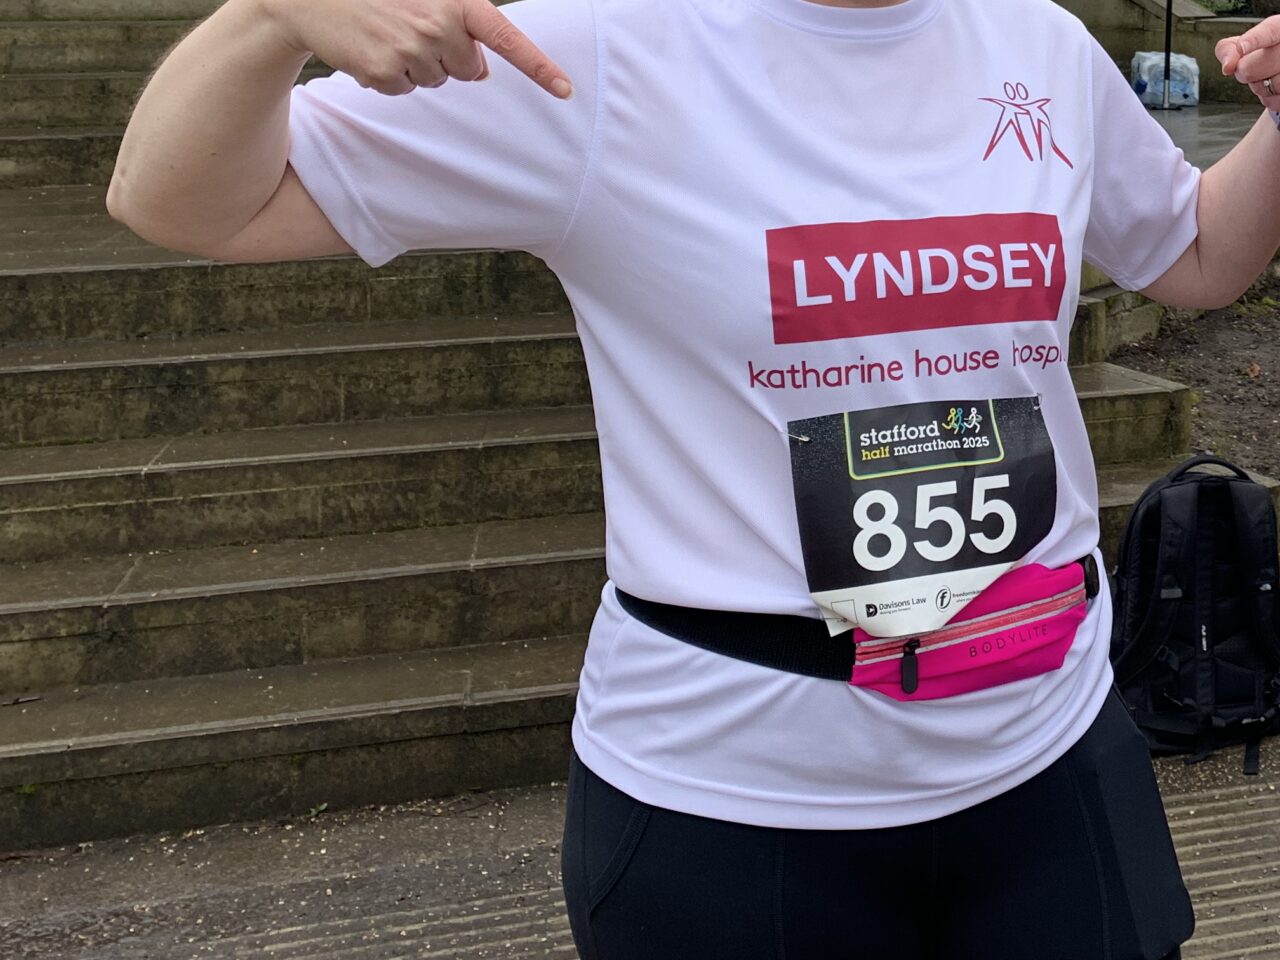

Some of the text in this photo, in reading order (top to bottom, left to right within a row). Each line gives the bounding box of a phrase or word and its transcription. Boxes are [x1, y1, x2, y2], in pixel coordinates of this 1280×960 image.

[793, 243, 1056, 307] LYNDSEY
[748, 355, 904, 389] katharine
[915, 349, 999, 377] house
[860, 421, 940, 447] stafford
[861, 436, 990, 461] half marathon 2025
[853, 474, 1017, 571] 855
[879, 600, 911, 611] Davisons
[912, 596, 926, 605] Law
[969, 624, 1048, 658] BODYLITE
